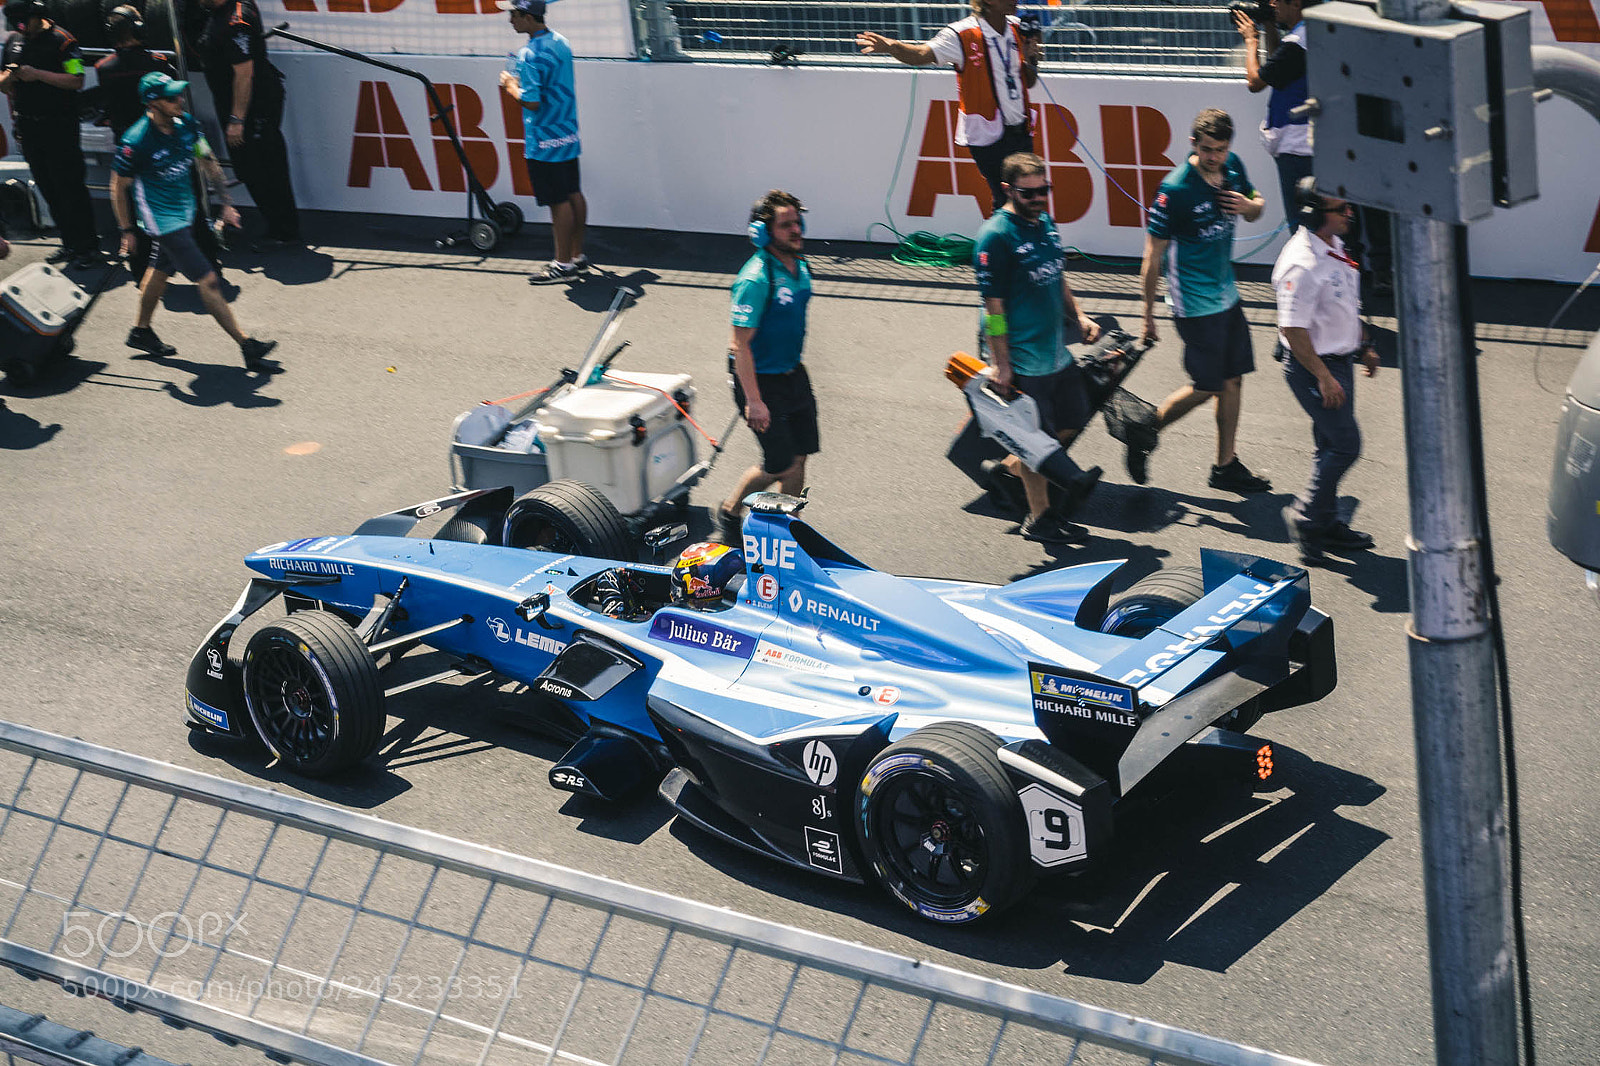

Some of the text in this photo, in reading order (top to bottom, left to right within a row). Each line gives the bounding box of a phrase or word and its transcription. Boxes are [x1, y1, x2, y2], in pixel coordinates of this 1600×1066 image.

[269, 557, 355, 576] RICHARD MILLE
[743, 535, 798, 570] BUE
[806, 599, 880, 632] RENAULT
[515, 628, 567, 656] LEMO
[668, 620, 742, 653] Julius Bär
[765, 649, 782, 659] ABB
[539, 680, 573, 698] Acronis
[1060, 684, 1124, 703] MICHELIN
[193, 703, 223, 723] MICHELIN
[1034, 699, 1136, 727] RICHARD MILLE
[807, 740, 833, 786] hp
[1044, 808, 1071, 850] 9
